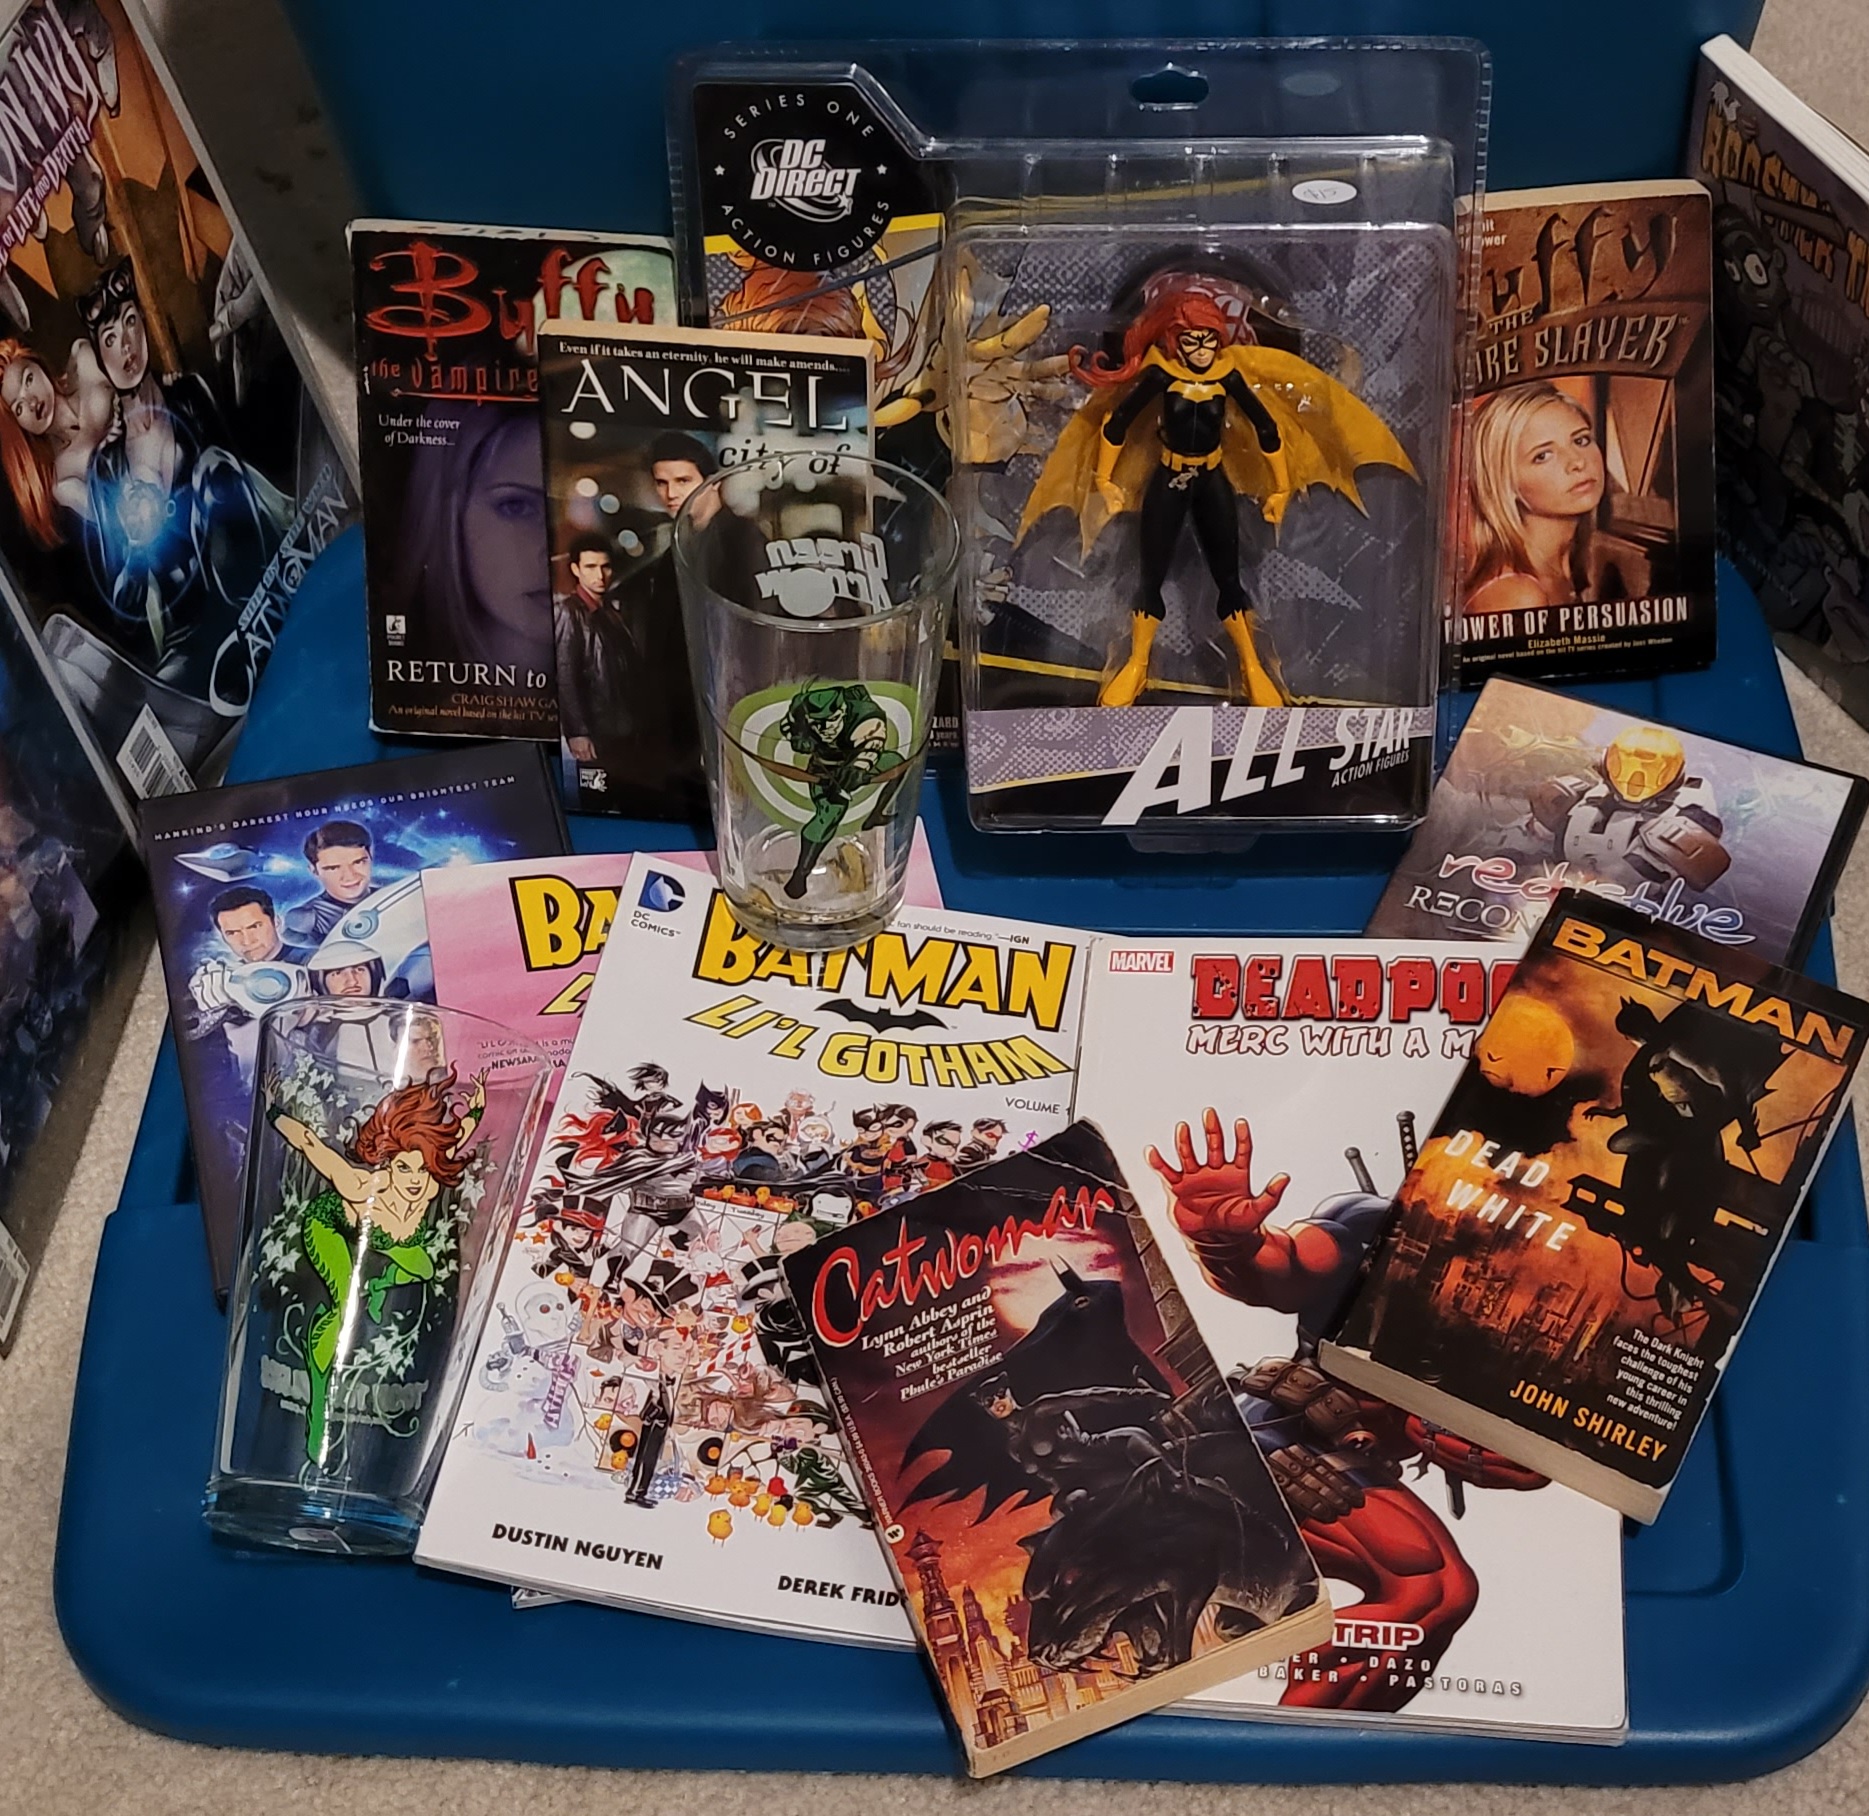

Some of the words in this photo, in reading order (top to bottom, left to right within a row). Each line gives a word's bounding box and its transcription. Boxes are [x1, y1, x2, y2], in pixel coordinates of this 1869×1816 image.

[724, 94, 804, 140] SERIES
[827, 101, 874, 138] ONE
[779, 139, 826, 169] DC
[7, 186, 41, 246] LIFE
[41, 115, 91, 194] DEATH
[721, 203, 795, 265] ACTION
[813, 201, 889, 266] FIGURES
[1489, 309, 1533, 334] THE
[1534, 313, 1677, 368] SLAYER
[371, 358, 400, 379] the
[559, 341, 588, 356] Even
[589, 344, 601, 357] if
[602, 346, 611, 357] it
[612, 346, 644, 359] takes
[645, 350, 660, 360] an
[714, 352, 729, 365] he
[731, 353, 753, 367] will
[755, 355, 788, 370] make
[561, 358, 847, 431] ANGEL
[378, 414, 413, 429] Under
[416, 416, 432, 430] the
[433, 418, 461, 431] cover
[385, 431, 396, 447] of
[718, 439, 794, 489] city
[808, 443, 850, 476] of
[1524, 609, 1549, 635] OF
[1559, 596, 1688, 632] PERSUASION
[1528, 636, 1571, 649] Elizabeth
[1573, 633, 1606, 645] Massie
[386, 660, 516, 687] RETURN
[527, 669, 547, 688] to
[389, 705, 402, 715] An
[405, 705, 438, 719] original
[439, 706, 461, 718] novel
[529, 711, 545, 721] TV
[451, 693, 494, 706] CRAIG
[496, 695, 538, 708] SHAW
[1329, 708, 1413, 771] STAR
[1100, 706, 1309, 826] ALL
[1331, 763, 1373, 789] ACTION
[1375, 749, 1411, 777] FIGURES
[154, 822, 226, 841] MANKIND'S
[232, 813, 290, 829] DARKEST
[295, 806, 329, 819] HOUR
[334, 799, 374, 813] NEEDS
[380, 794, 404, 805] OUR
[409, 782, 478, 801] BRIGHTEST
[483, 775, 516, 788] TEAM
[630, 919, 675, 938] COMICS
[632, 910, 650, 921] DC
[913, 922, 942, 934] should
[944, 926, 956, 935] be
[692, 888, 1077, 1033] BATMAN
[1111, 951, 1172, 972] MARVEL
[1551, 916, 1856, 1060] BATMAN
[684, 994, 820, 1060] LI'L
[818, 1031, 1076, 1089] GOTHAM
[1186, 1025, 1289, 1056] MERC
[1300, 1026, 1392, 1058] WITH
[1404, 1026, 1431, 1059] A
[1005, 1096, 1060, 1115] VOLUME
[1444, 1129, 1550, 1188] DEAD
[1446, 1178, 1577, 1252] WHITE
[812, 1186, 1115, 1348] Catwoman
[860, 1324, 904, 1352] Lynn
[909, 1303, 958, 1330] Abbey
[961, 1286, 991, 1309] and
[882, 1327, 936, 1358] Robert
[940, 1305, 995, 1334] Asprin
[910, 1331, 959, 1359] authors
[959, 1323, 974, 1341] of
[975, 1316, 996, 1333] the
[895, 1355, 923, 1377] New
[924, 1341, 957, 1366] York
[959, 1328, 999, 1351] Times
[932, 1344, 992, 1376] bestseller
[1613, 1335, 1637, 1355] faces
[1640, 1346, 1656, 1362] the
[1656, 1352, 1699, 1382] toughest
[1633, 1328, 1650, 1345] The
[1651, 1335, 1672, 1356] Dark
[1672, 1345, 1705, 1369] Knight
[900, 1374, 946, 1401] Phule's
[947, 1351, 1004, 1382] Paradise
[1616, 1367, 1646, 1391] young
[1646, 1380, 1677, 1401] career
[1677, 1393, 1688, 1406] in
[1620, 1355, 1664, 1380] challenge
[1665, 1373, 1678, 1387] of
[1678, 1378, 1693, 1394] his
[1509, 1379, 1570, 1418] JOHN
[1573, 1407, 1668, 1462] SHIRLEY
[1606, 1394, 1629, 1410] new
[1630, 1402, 1677, 1431] adventure!
[1625, 1386, 1645, 1403] this
[1645, 1395, 1682, 1420] thrilling
[492, 1523, 569, 1552] DUSTIN
[574, 1540, 665, 1571] NGUYEN
[777, 1575, 845, 1600] DEREK
[1333, 1620, 1423, 1649] TRIP
[1258, 1666, 1339, 1683] BAKER
[1389, 1674, 1523, 1696] PASTORAS
[1369, 1656, 1431, 1673] DAZO
